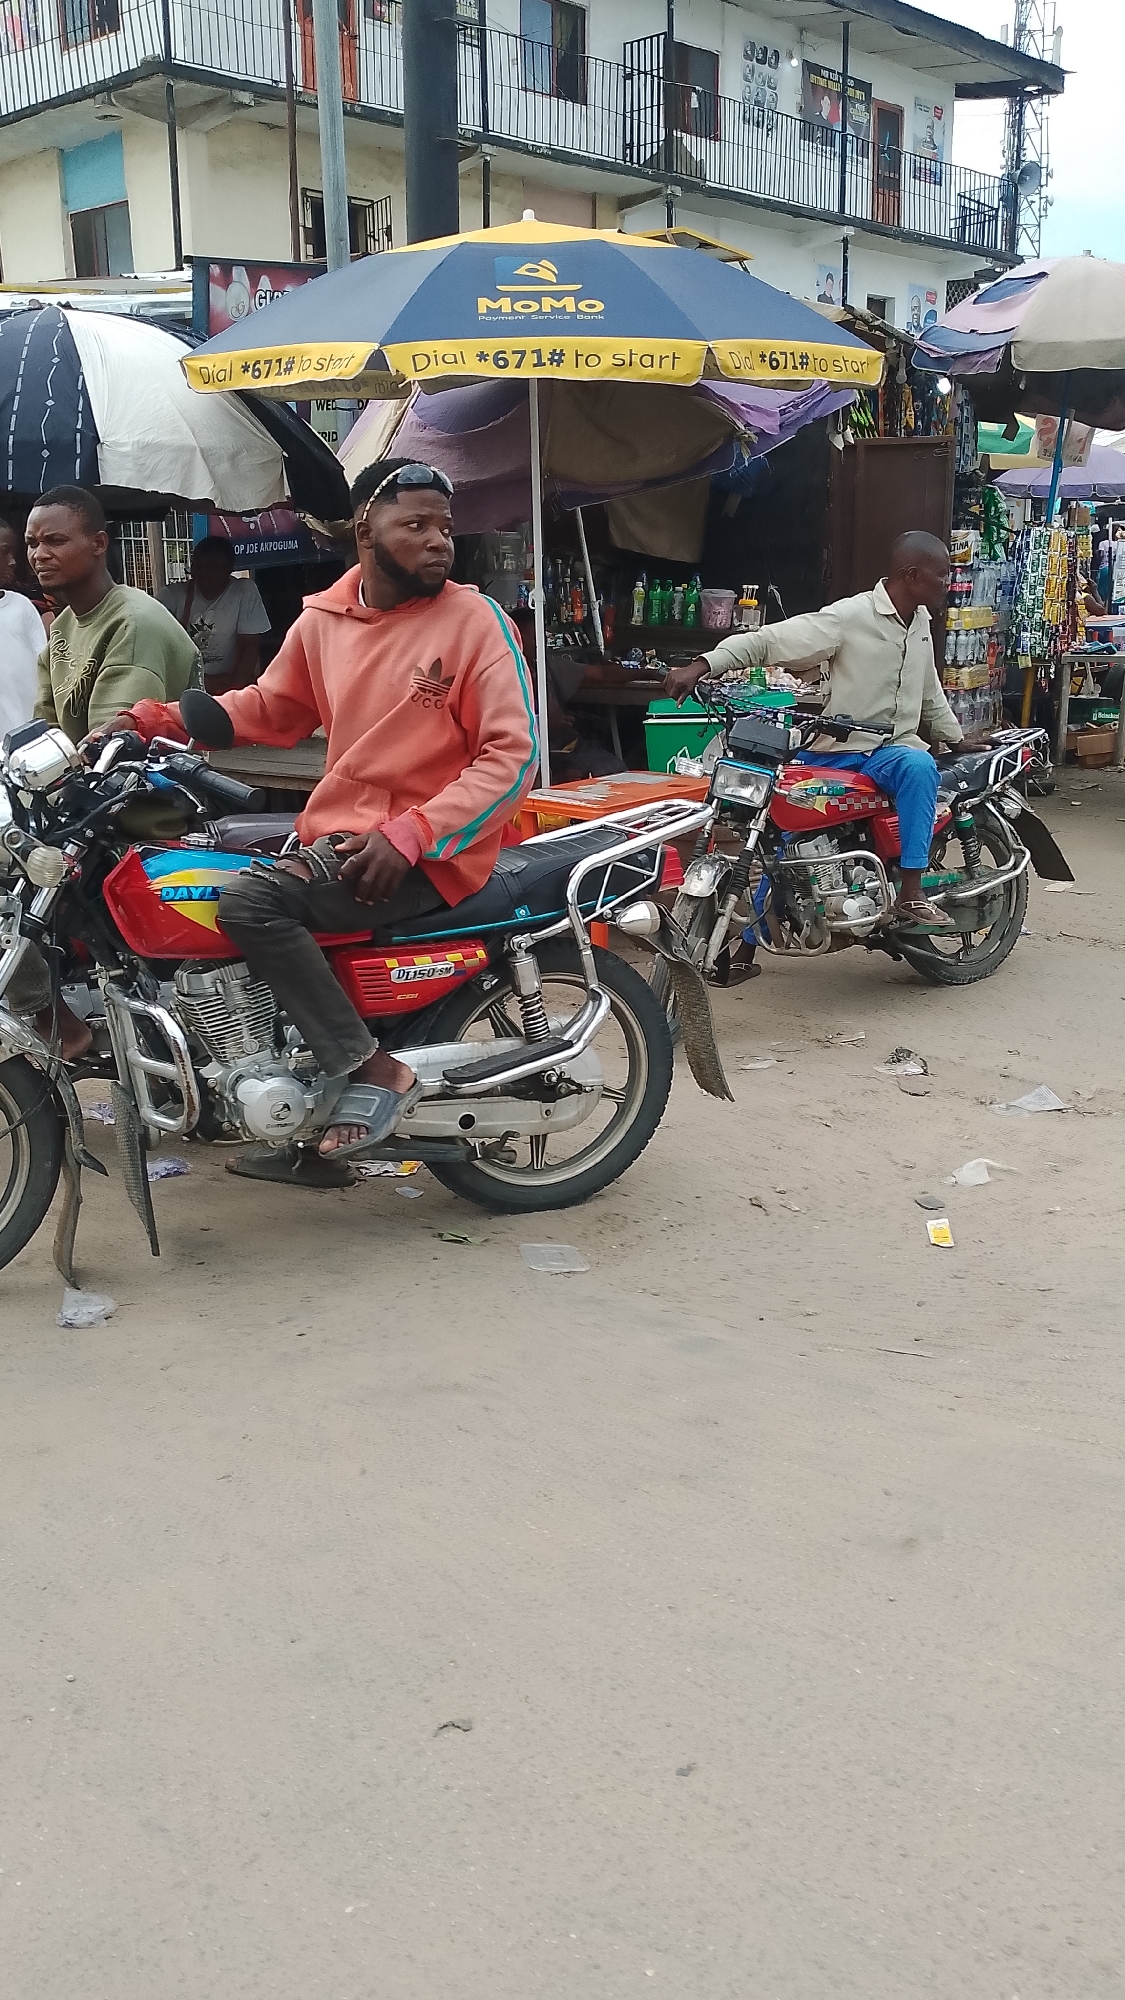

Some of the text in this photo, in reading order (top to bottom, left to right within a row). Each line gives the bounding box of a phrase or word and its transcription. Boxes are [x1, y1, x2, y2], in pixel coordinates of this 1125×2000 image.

[477, 296, 605, 313] MoMo
[478, 314, 526, 322] Payment
[199, 359, 233, 385] Dial
[297, 355, 312, 374] to
[313, 352, 356, 372] start
[411, 350, 467, 373] Dial
[574, 350, 602, 368] to
[611, 348, 681, 370] start
[728, 351, 755, 371] Dial
[812, 352, 829, 373] to
[245, 542, 258, 554] JOE
[950, 540, 969, 552] TINA
[162, 886, 221, 901] DAYL
